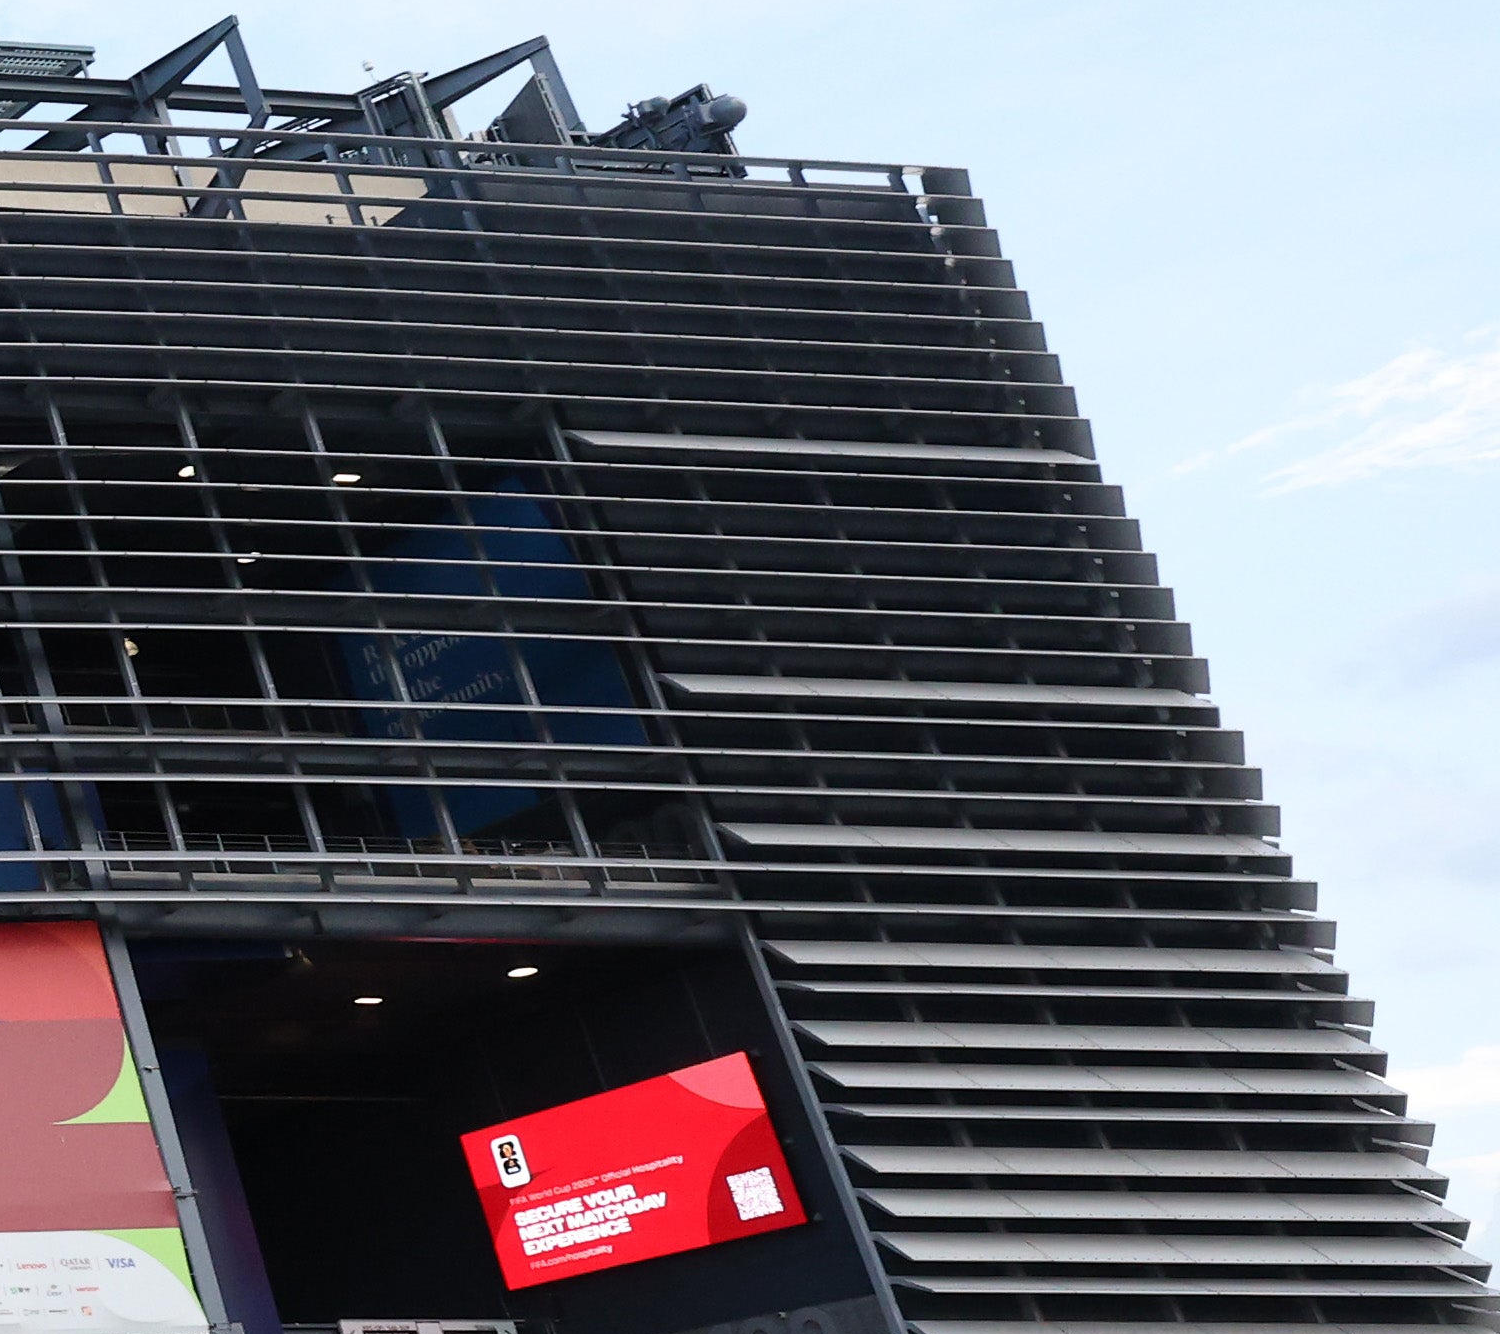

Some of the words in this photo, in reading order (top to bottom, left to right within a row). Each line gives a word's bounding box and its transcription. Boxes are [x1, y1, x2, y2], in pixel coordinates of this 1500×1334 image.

[529, 1189, 553, 1202] World
[554, 1185, 572, 1195] Cup
[601, 1168, 631, 1182] Official
[632, 1155, 683, 1174] Hospitality
[515, 1197, 584, 1226] SECURE
[584, 1184, 636, 1208] YOUR
[519, 1218, 565, 1241] NEXT
[567, 1192, 667, 1229] MATCHDAY
[523, 1218, 632, 1256] EXPERIENCE
[530, 1244, 614, 1270] FIFA.com/hospitality
[106, 1258, 136, 1269] VISA
